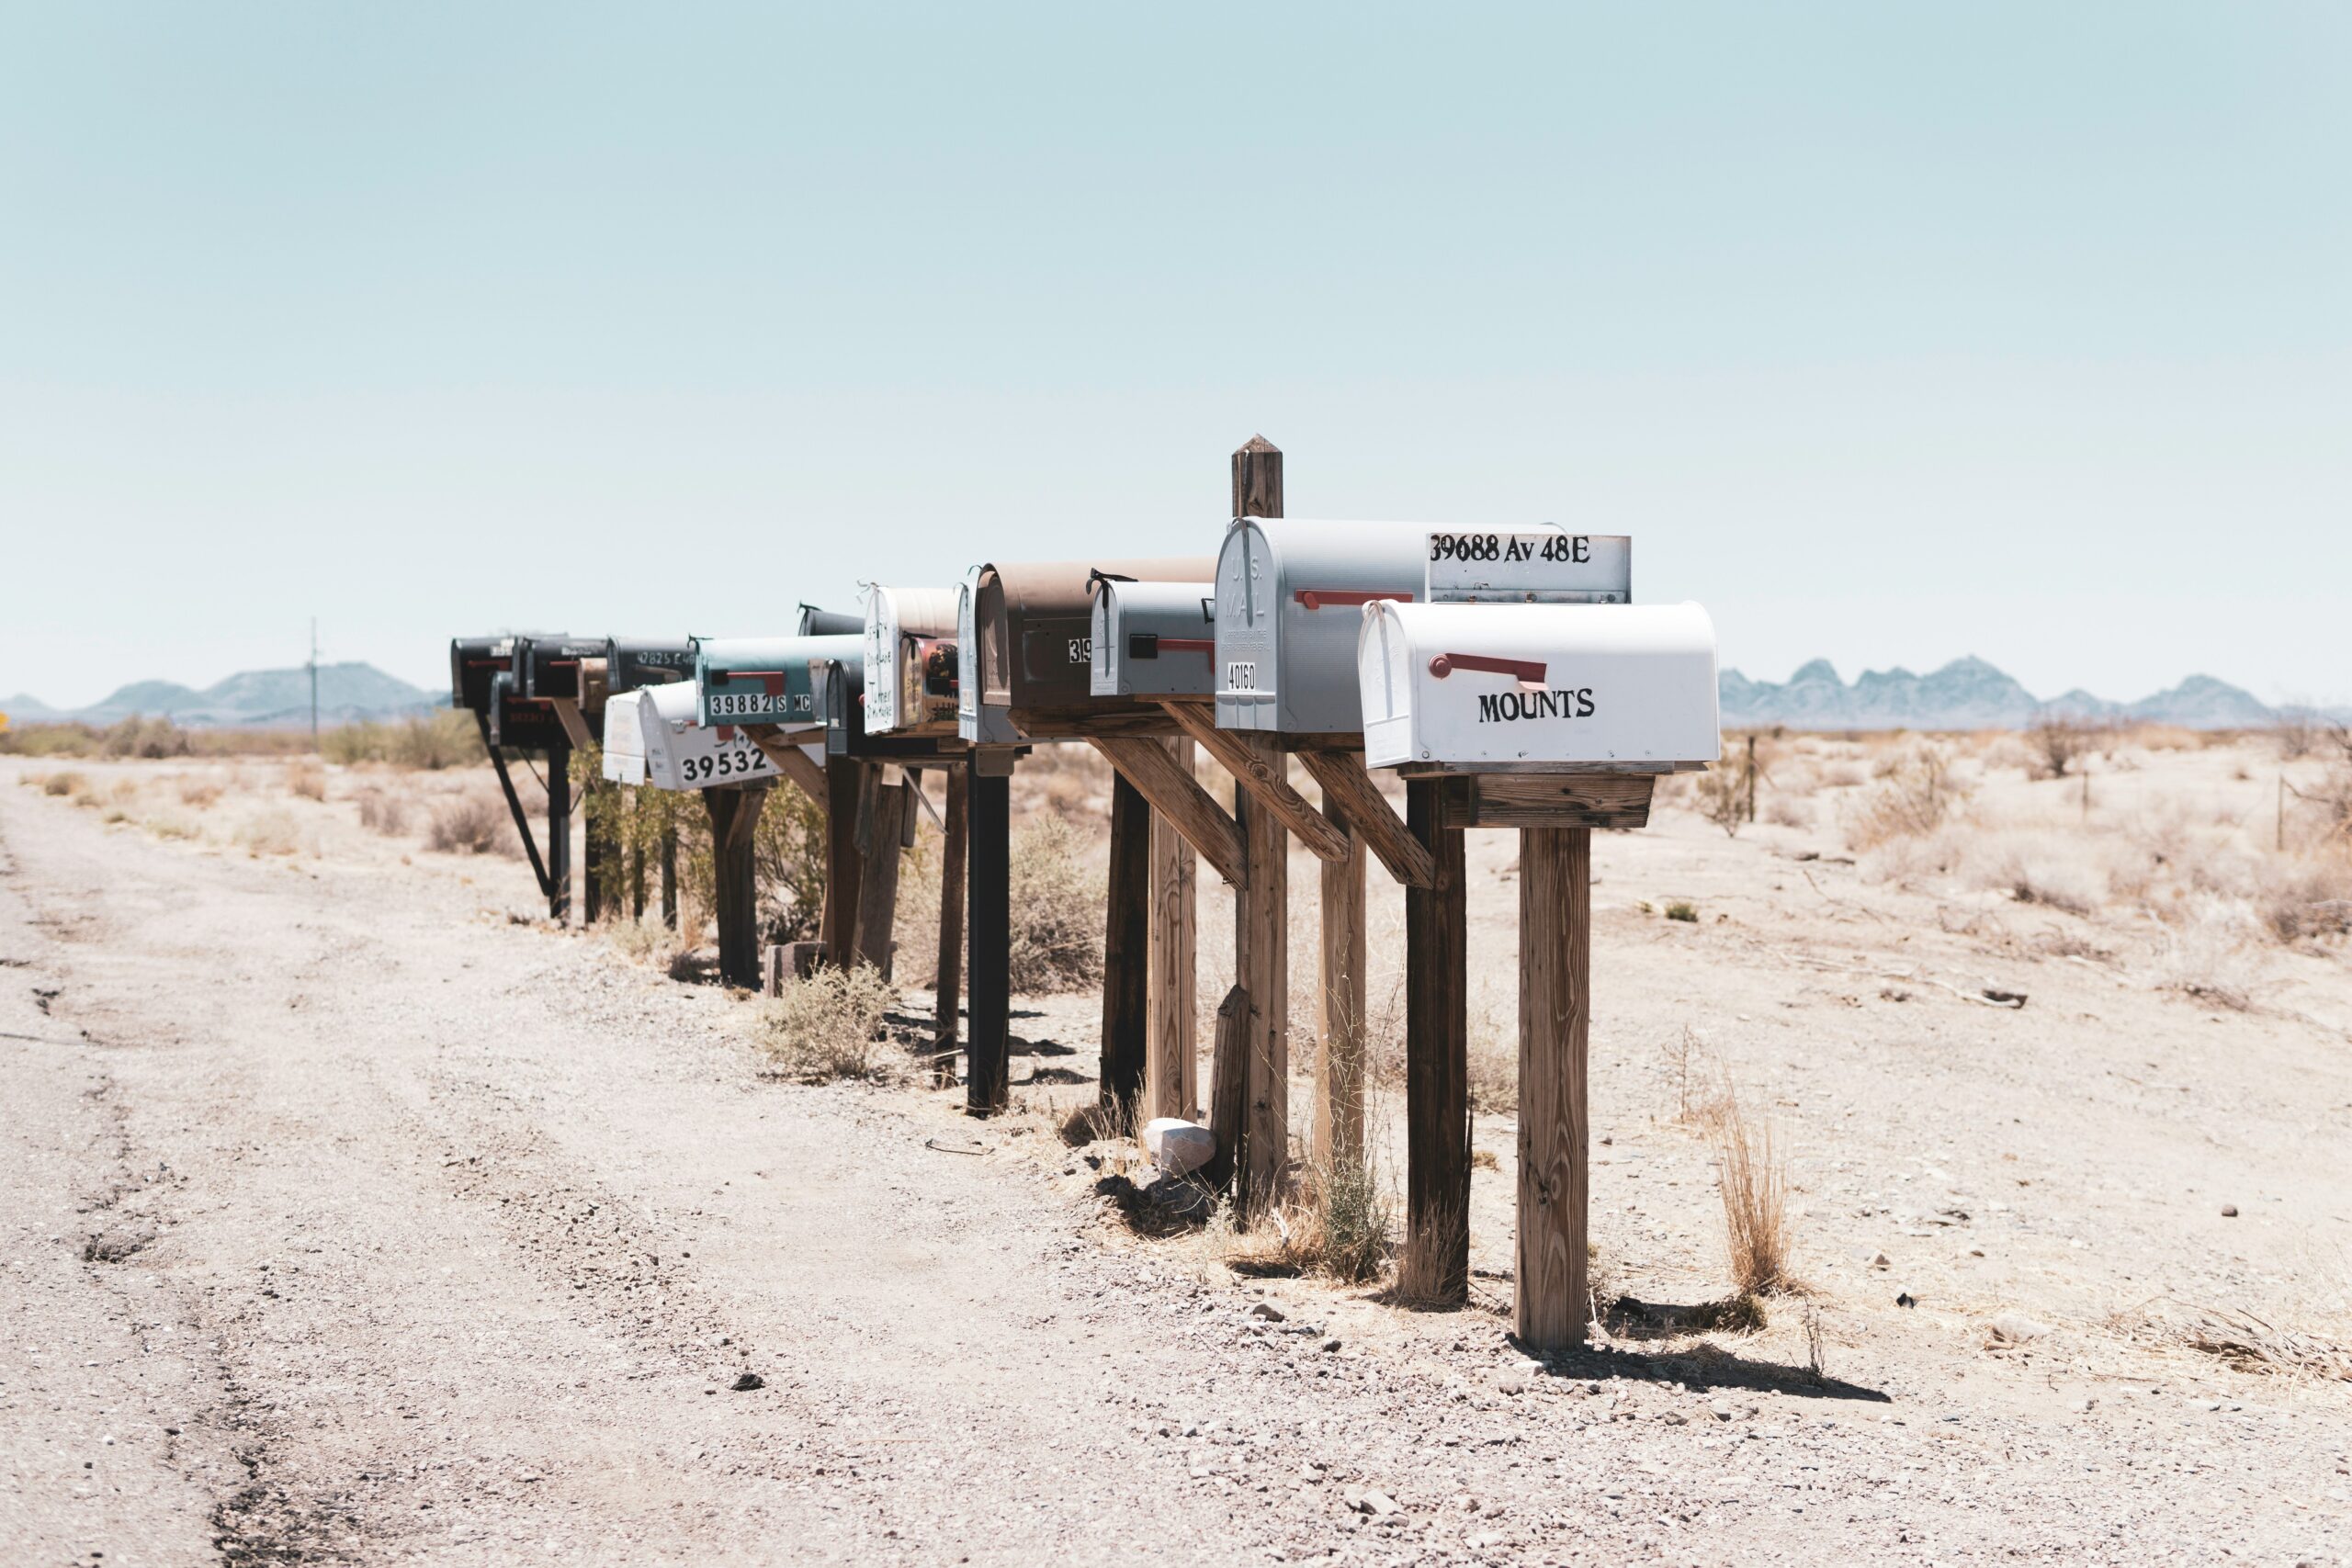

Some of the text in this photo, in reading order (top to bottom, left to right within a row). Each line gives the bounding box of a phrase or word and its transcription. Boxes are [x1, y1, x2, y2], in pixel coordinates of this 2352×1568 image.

[1430, 535, 1590, 563] 39688 Av 48E
[1226, 593, 1265, 617] MAL
[638, 651, 671, 664] 42825
[1228, 664, 1255, 690] 40160
[713, 694, 809, 714] 39882 S MC
[1478, 688, 1595, 723] MOUNTS
[683, 748, 767, 781] 39532
